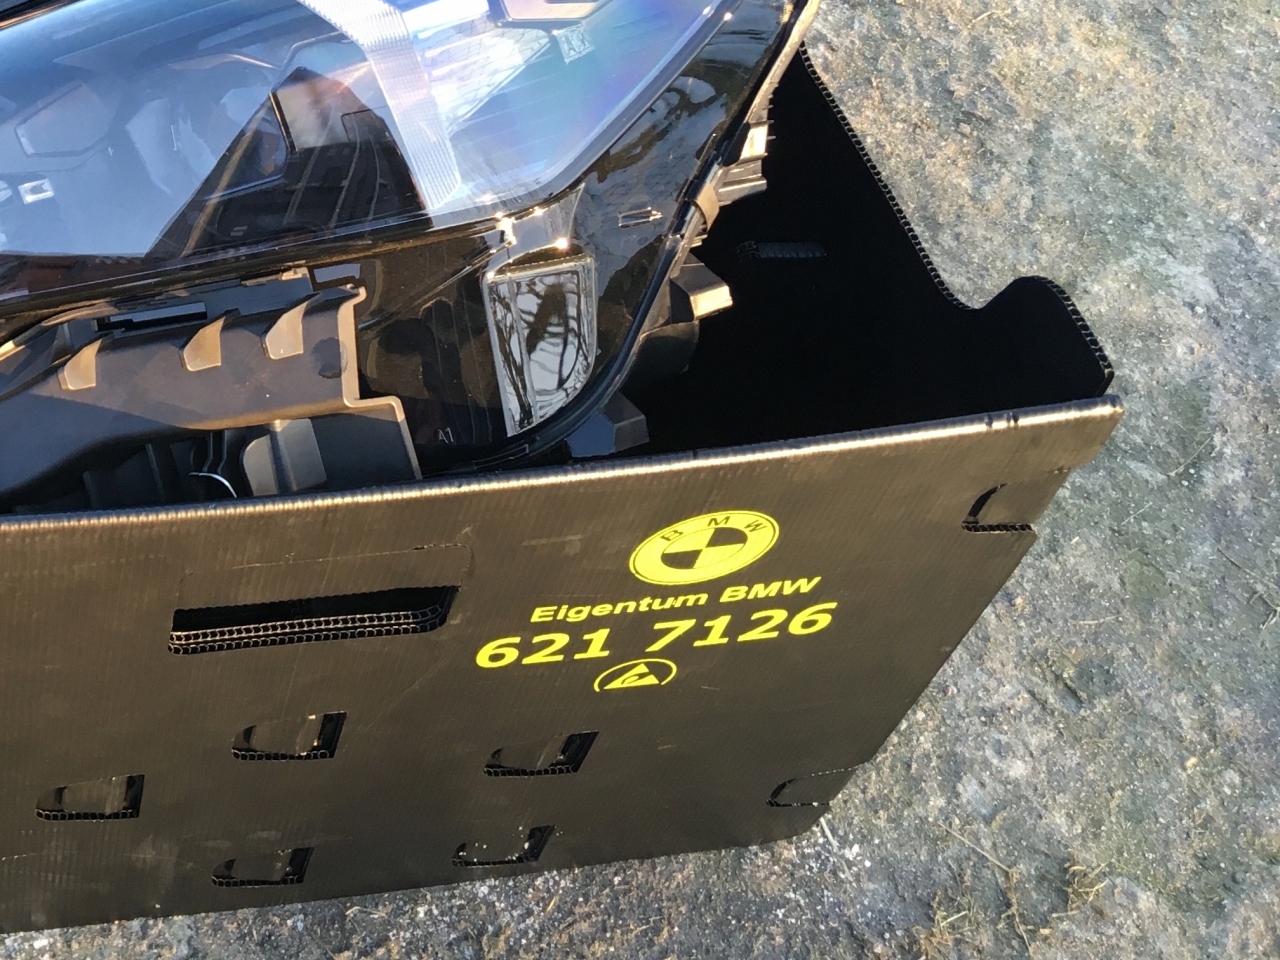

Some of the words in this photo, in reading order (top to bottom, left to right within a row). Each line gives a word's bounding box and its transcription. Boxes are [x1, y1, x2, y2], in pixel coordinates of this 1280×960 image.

[661, 515, 767, 542] BMW
[530, 592, 708, 623] Eigentum
[719, 576, 822, 604] BMW
[475, 627, 611, 670] 621
[645, 601, 839, 653] 7126
